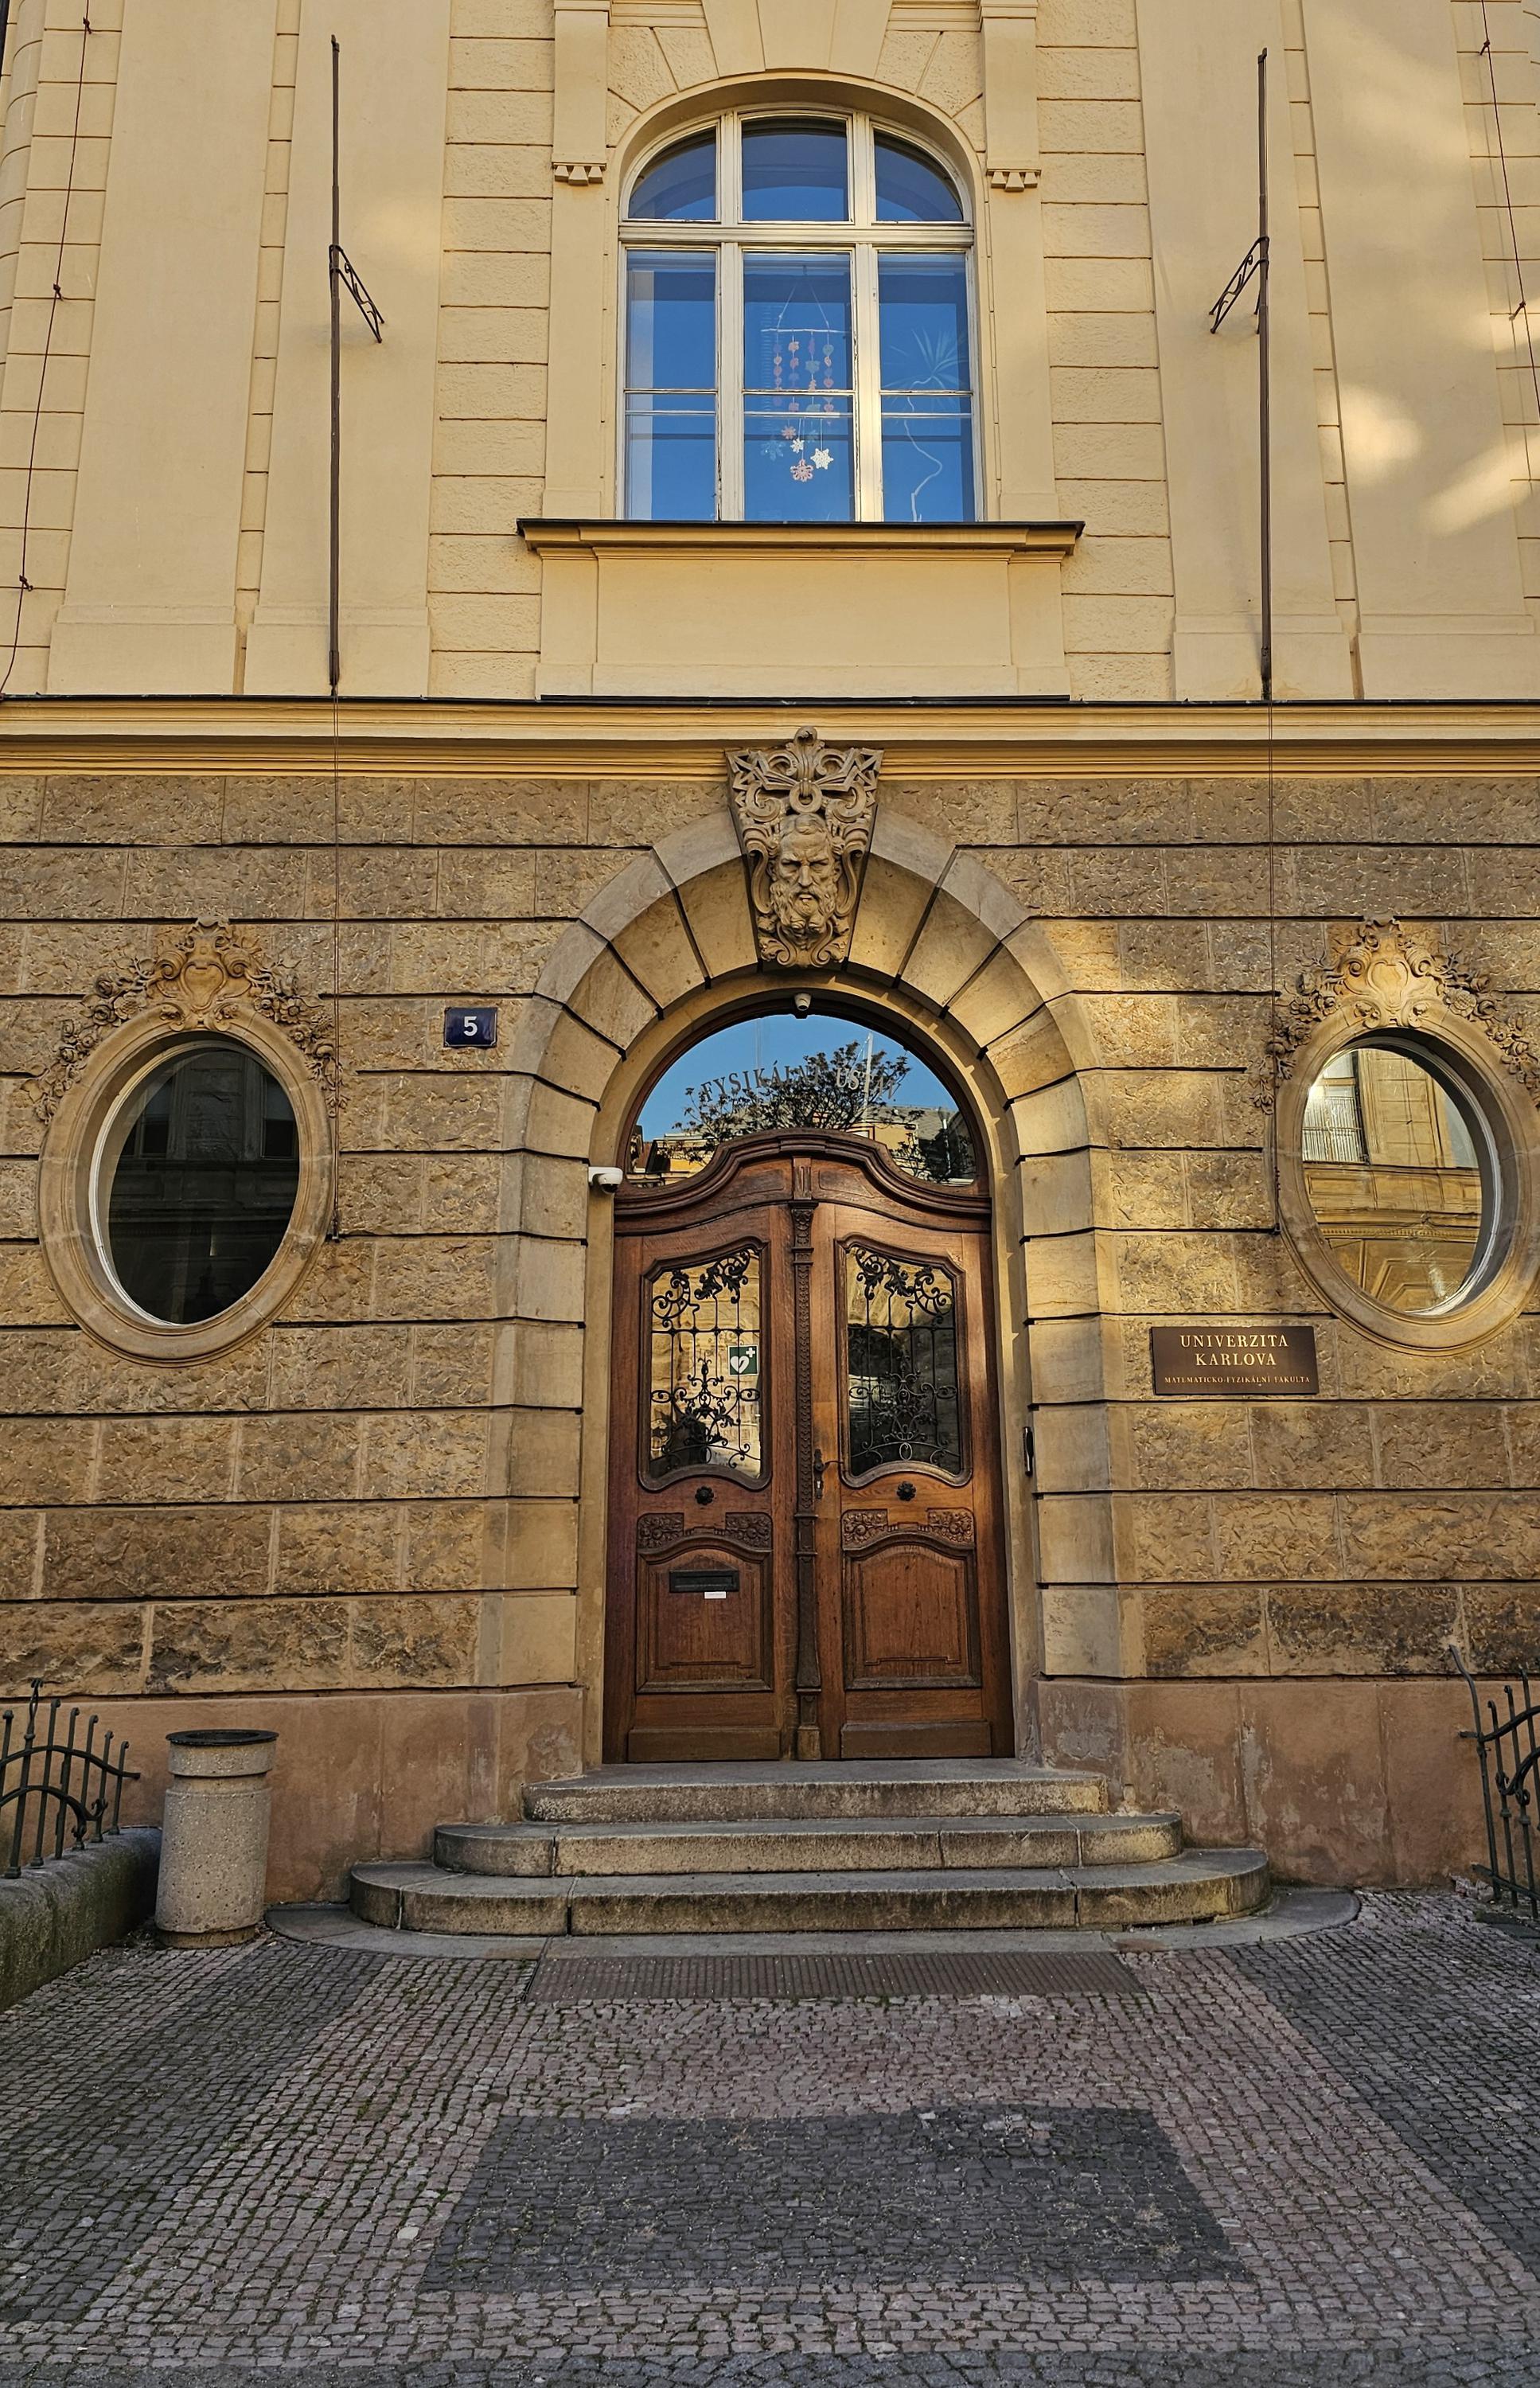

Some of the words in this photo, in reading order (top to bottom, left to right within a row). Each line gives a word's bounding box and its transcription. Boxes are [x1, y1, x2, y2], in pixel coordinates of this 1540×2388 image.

[463, 1016, 478, 1036] 5
[1179, 1334, 1289, 1348] UNIVERZITA
[1195, 1352, 1277, 1366] KARLOVA
